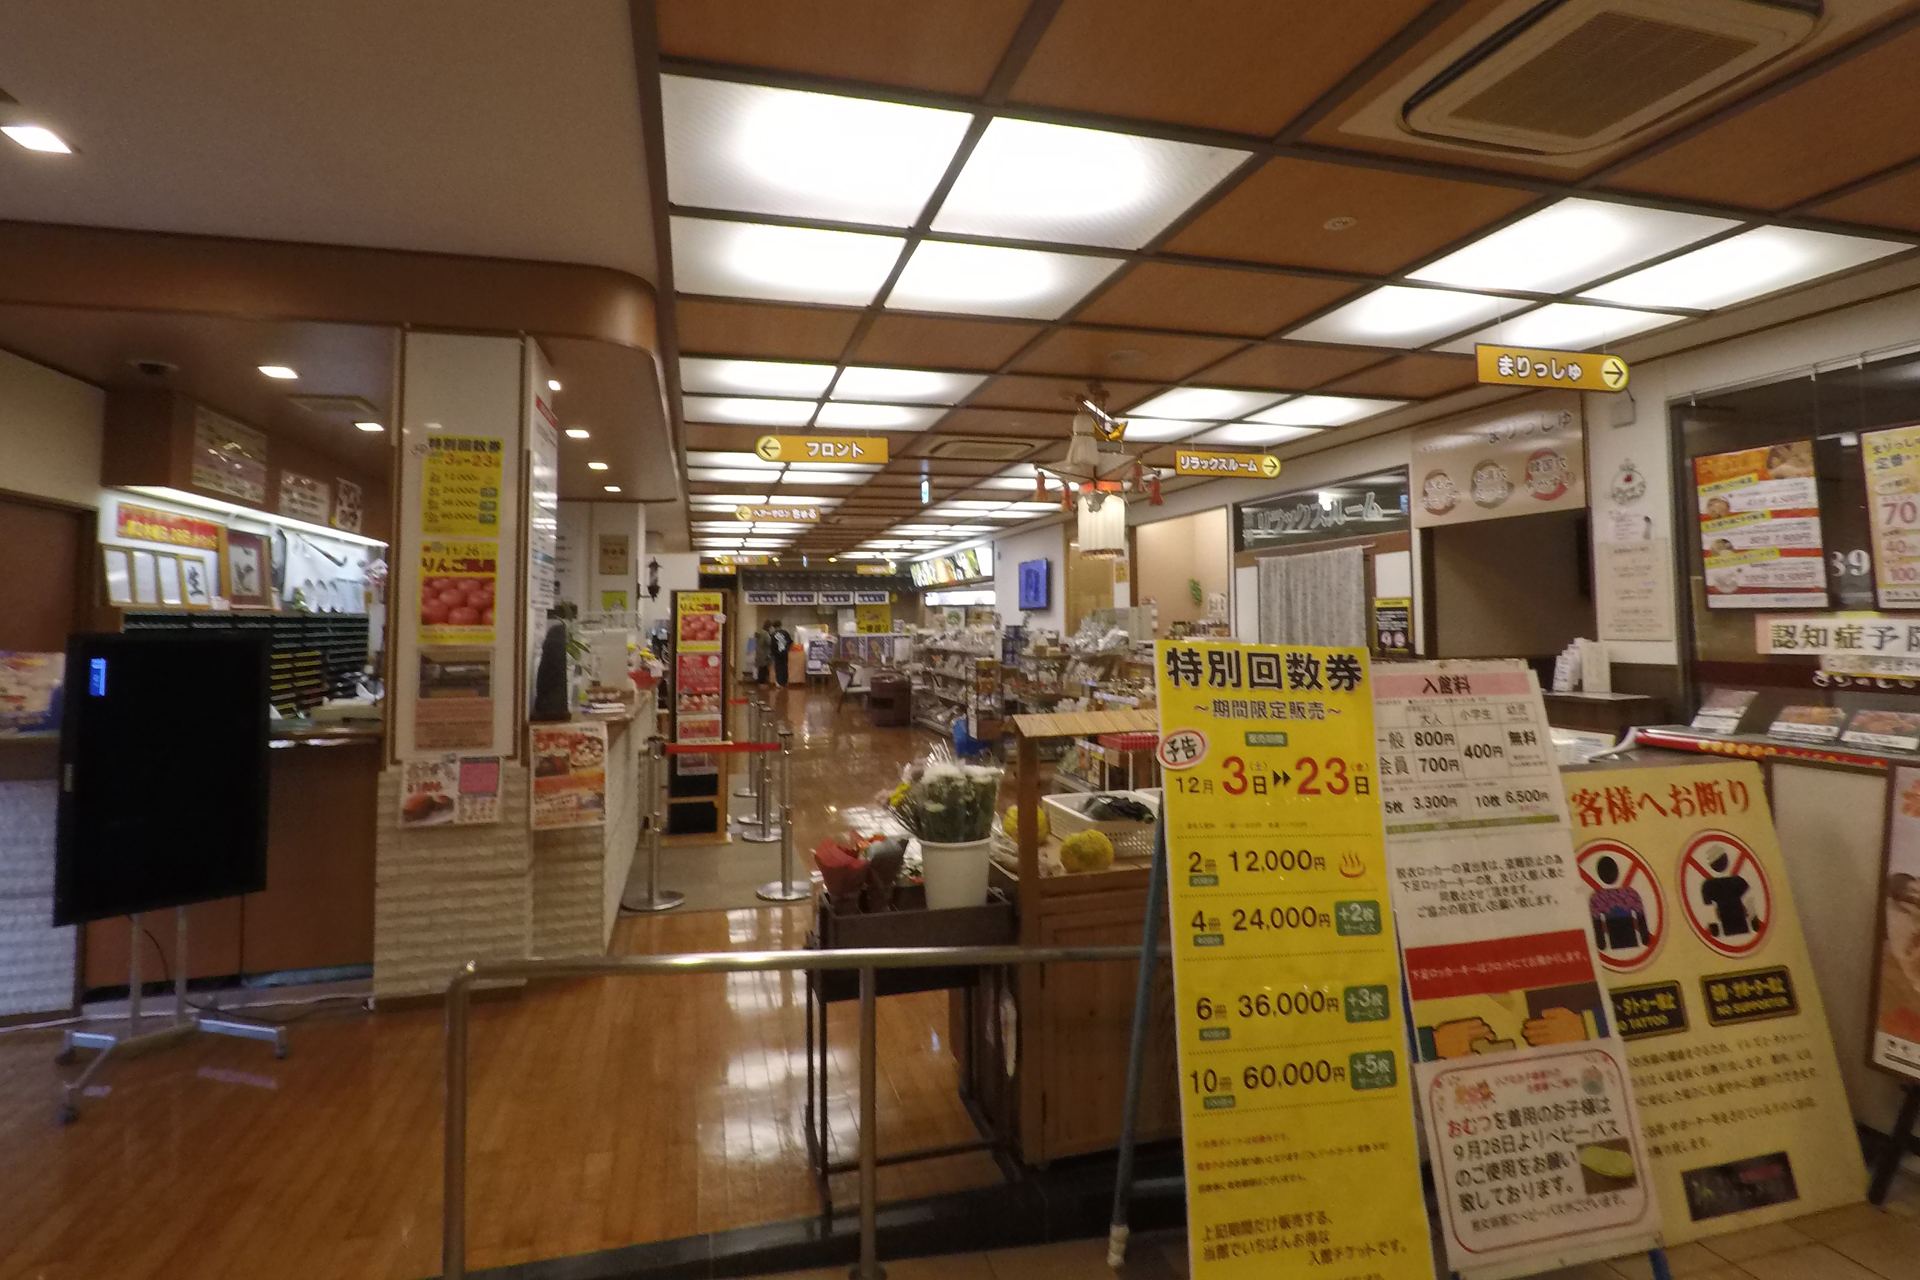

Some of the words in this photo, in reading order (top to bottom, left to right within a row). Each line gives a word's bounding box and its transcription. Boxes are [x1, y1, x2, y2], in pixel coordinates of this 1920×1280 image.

[1497, 355, 1582, 381] まりっしゅ
[806, 441, 864, 458] フロント
[1180, 456, 1258, 472] リラックスルーム
[1166, 647, 1363, 692] 特別回数券
[1422, 675, 1472, 695] 入館料
[1414, 731, 1456, 746] 800円
[1508, 730, 1537, 746] 無料
[1464, 744, 1504, 759] 400円
[1418, 757, 1461, 773] 700円
[1228, 850, 1326, 873] 12,000円
[1232, 906, 1331, 931] 24,000円
[1238, 991, 1340, 1018] 36,000円
[1243, 1060, 1346, 1089] 60,000円
